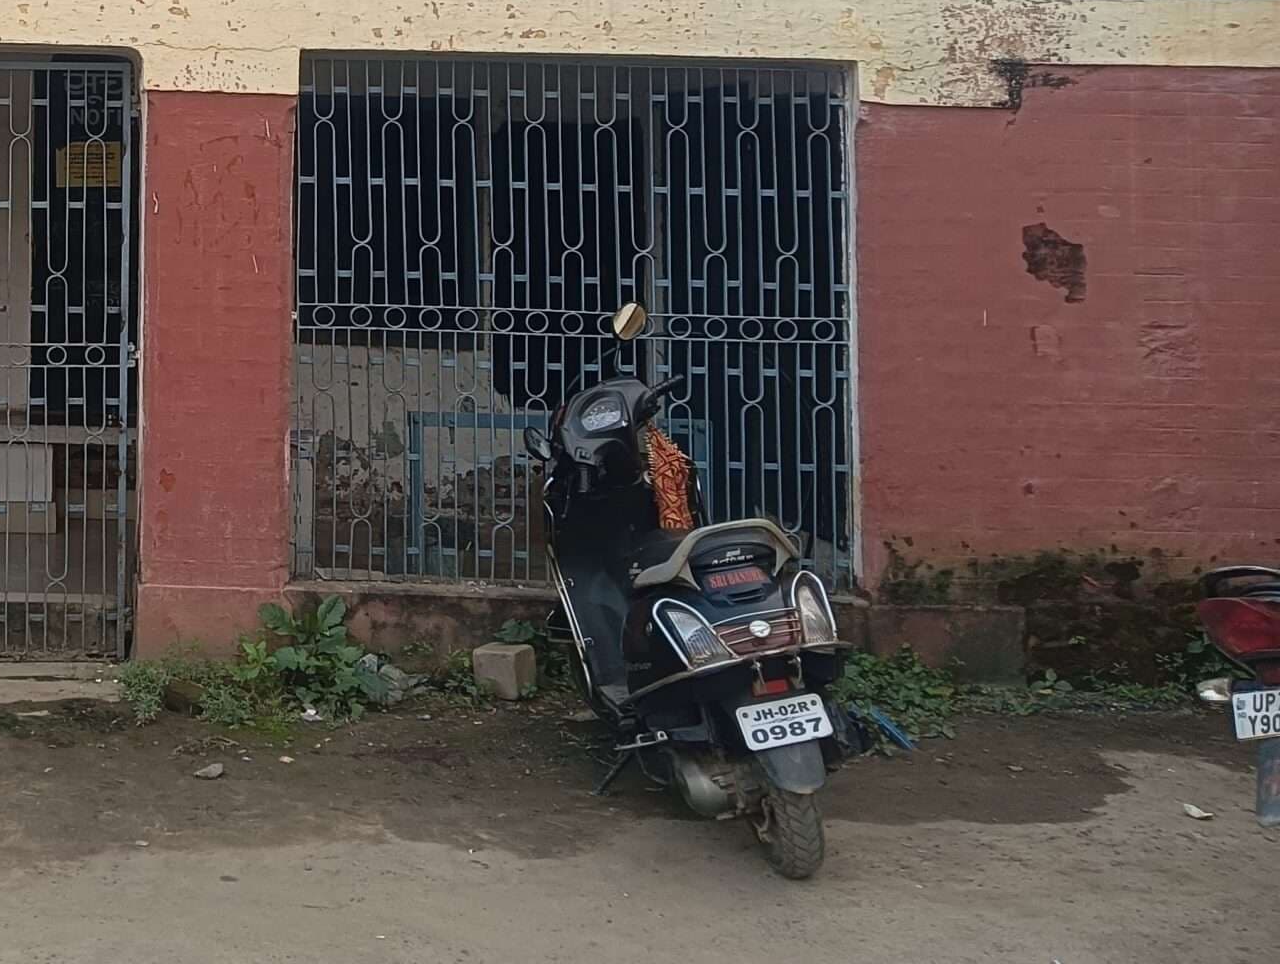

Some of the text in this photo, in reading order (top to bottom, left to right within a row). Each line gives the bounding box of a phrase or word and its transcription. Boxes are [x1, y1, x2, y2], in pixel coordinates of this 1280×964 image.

[70, 108, 122, 125] NOTI
[753, 701, 810, 722] JH-02R
[1252, 692, 1280, 713] UP
[751, 717, 823, 744] 0987
